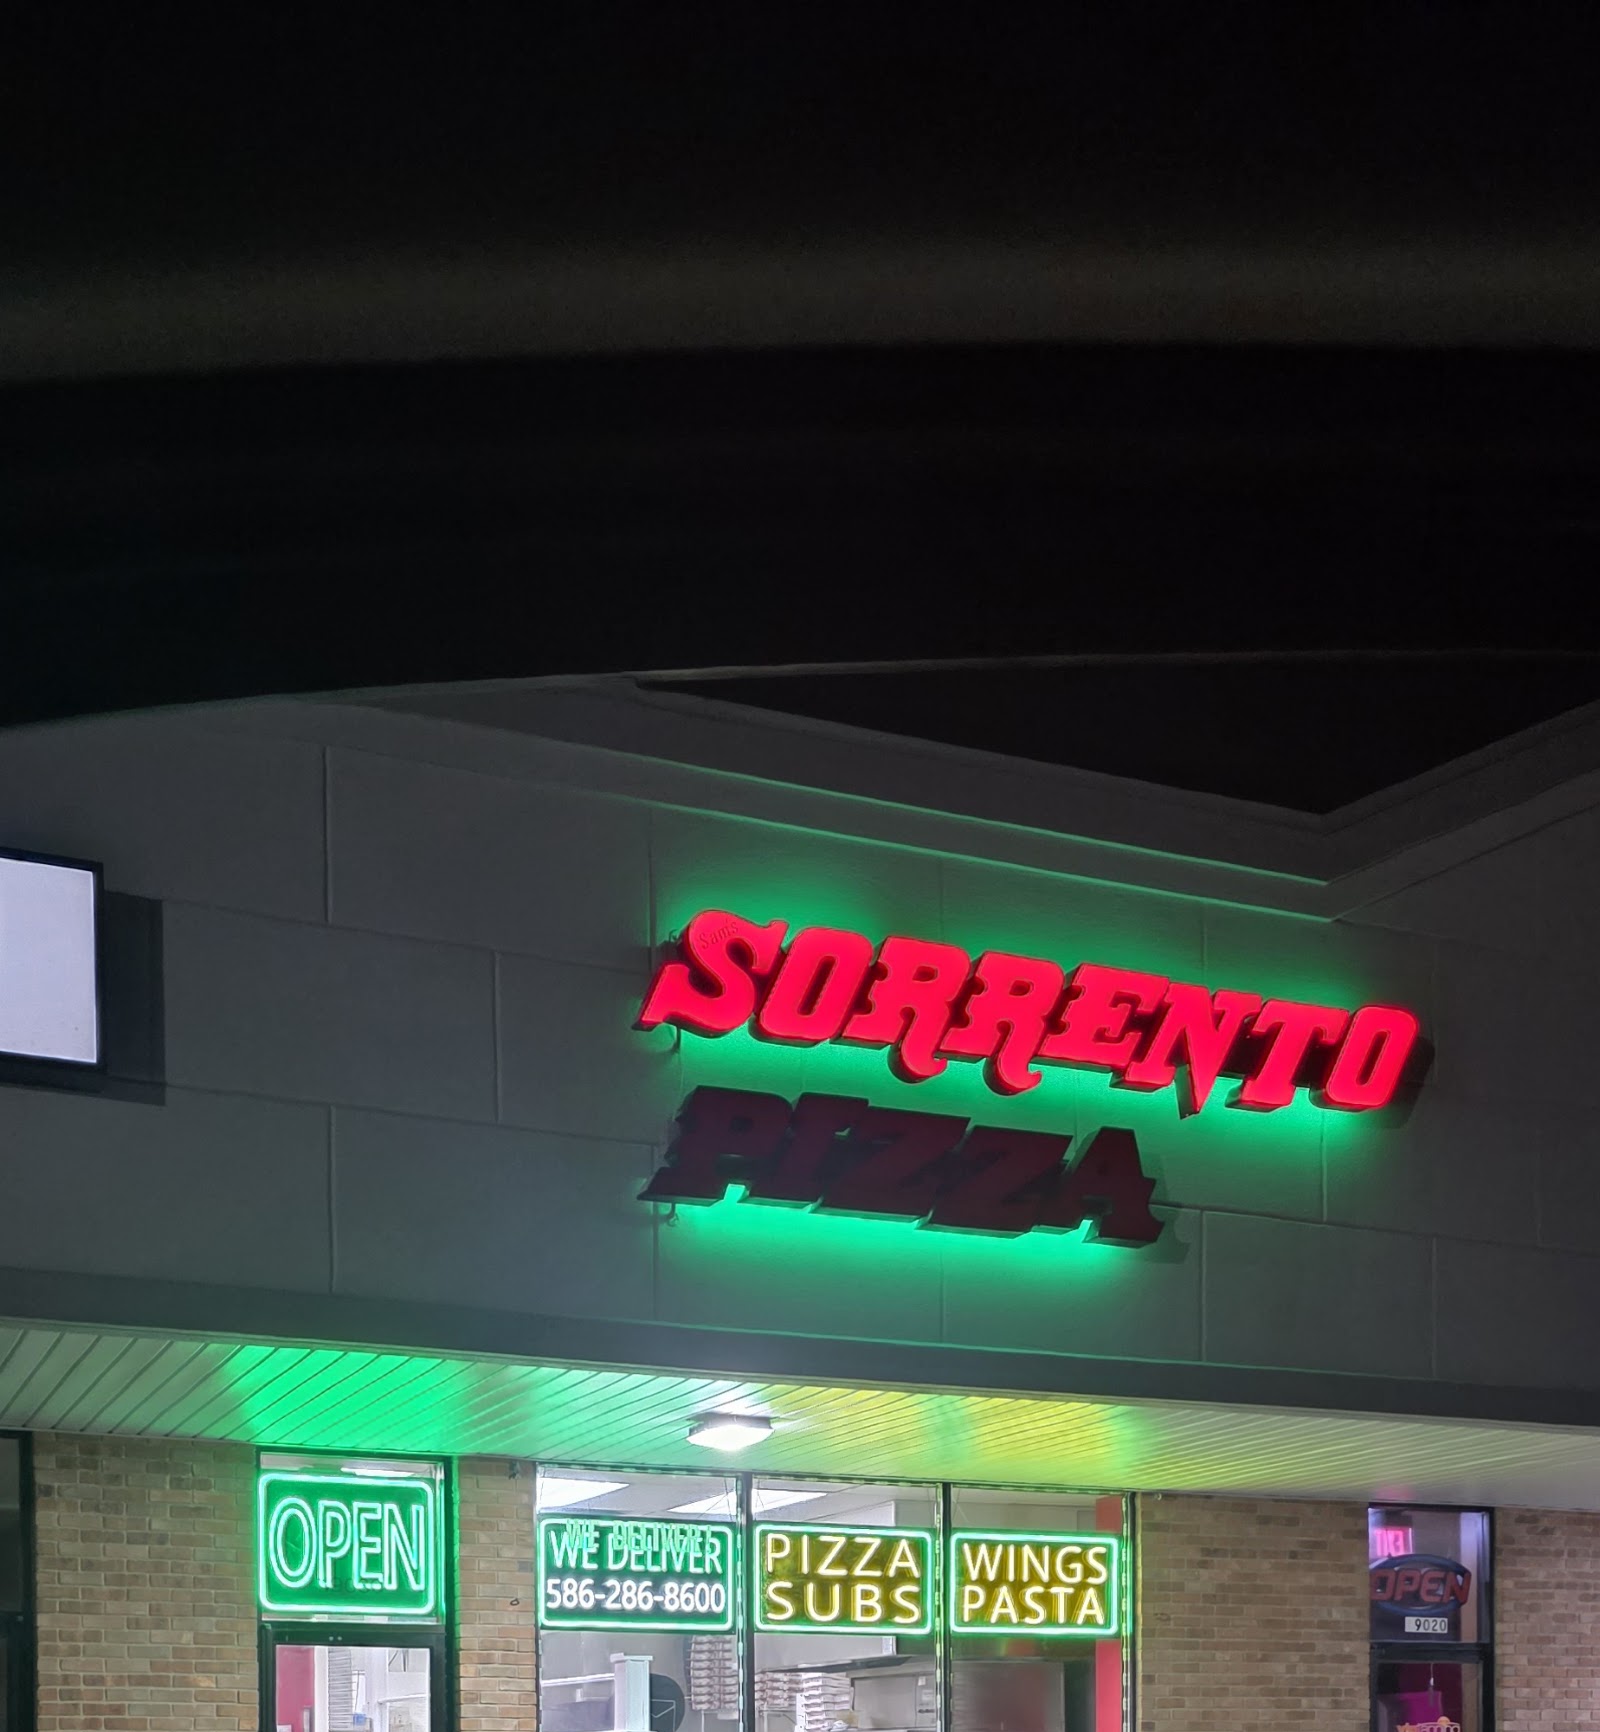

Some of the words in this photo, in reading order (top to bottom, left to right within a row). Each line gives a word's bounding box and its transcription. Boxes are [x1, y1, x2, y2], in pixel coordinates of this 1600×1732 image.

[634, 909, 1420, 1120] SORRENTO
[637, 1084, 1166, 1248] PIZZA
[269, 1497, 425, 1591] OPEN
[549, 1530, 598, 1569] WE
[608, 1532, 723, 1574] DELIVER
[766, 1533, 920, 1578] PIZZA
[963, 1542, 1108, 1585] WINGS
[546, 1577, 725, 1613] 586-286-8600
[766, 1581, 920, 1624] SUBS
[963, 1585, 1104, 1625] PASTA
[1370, 1568, 1472, 1605] OPEN
[1415, 1618, 1447, 1631] 9020
